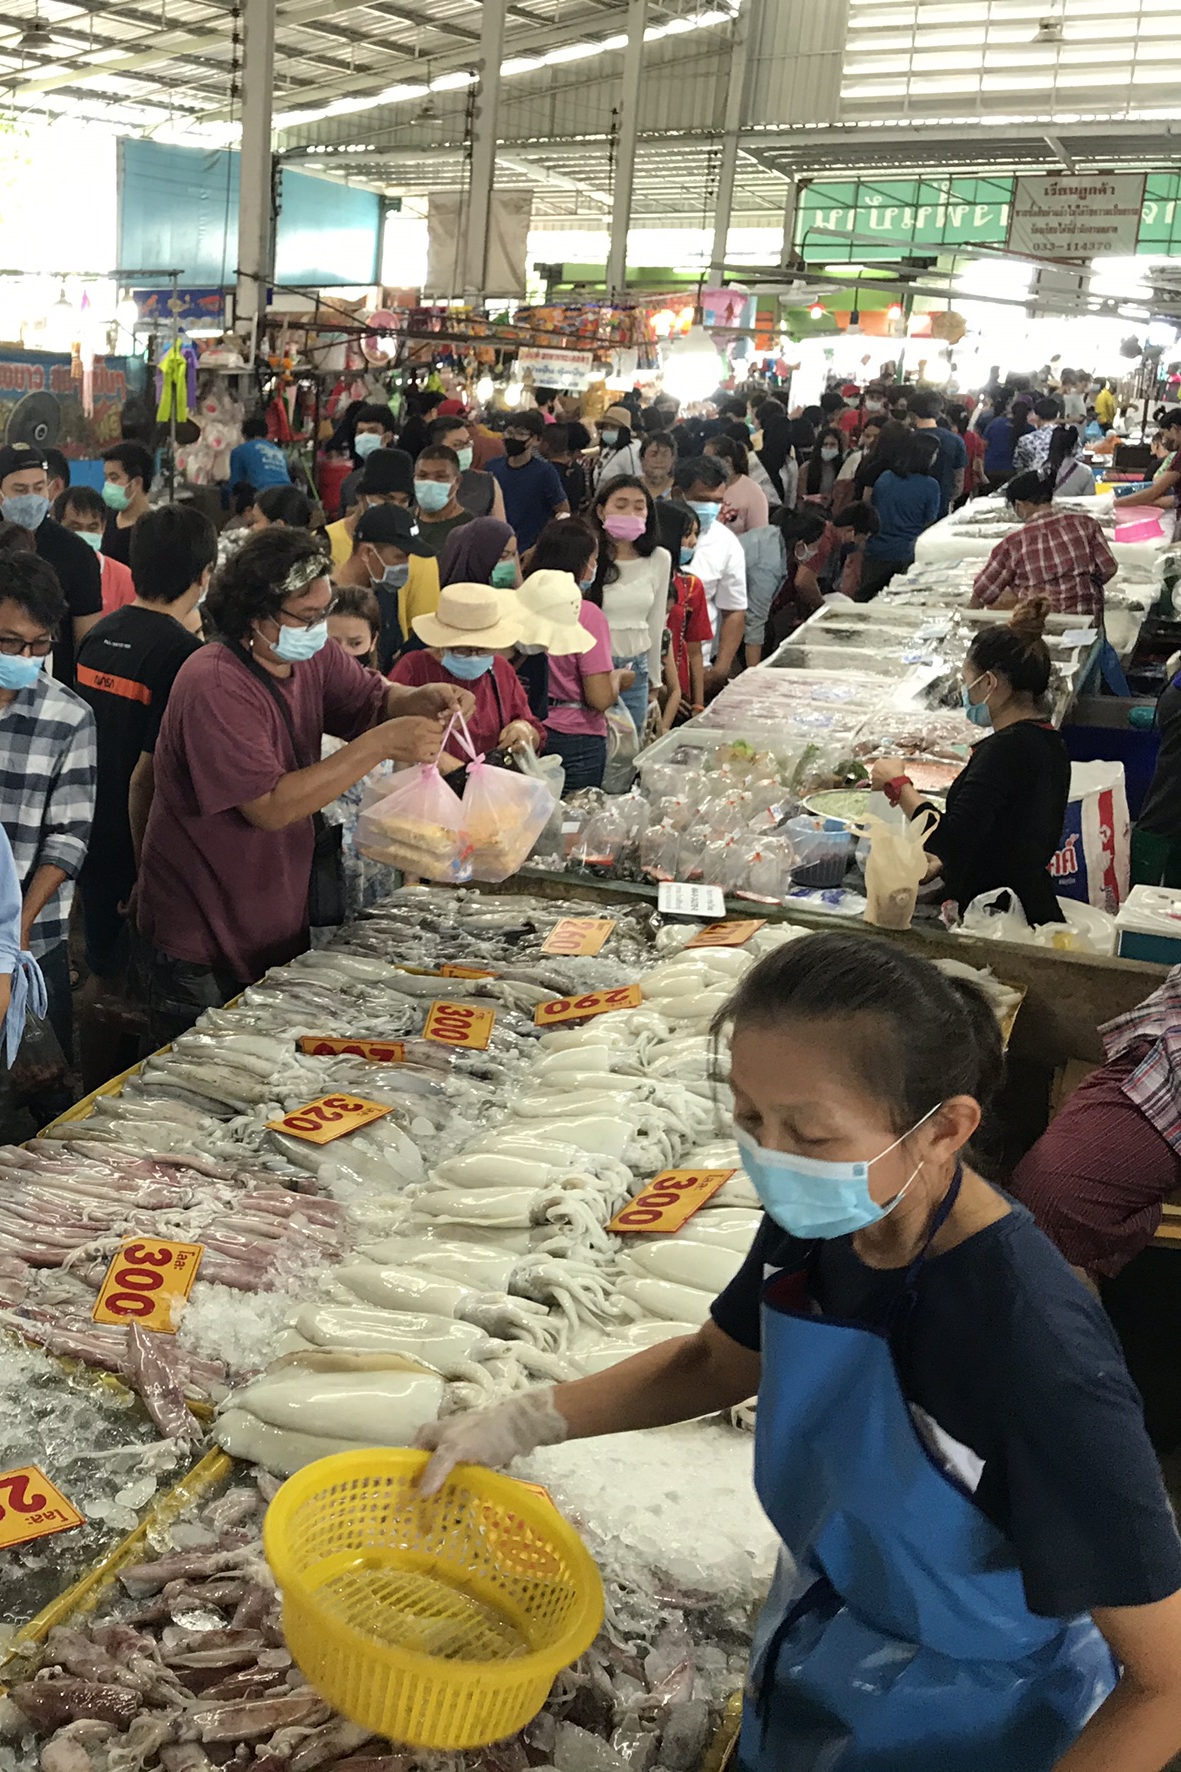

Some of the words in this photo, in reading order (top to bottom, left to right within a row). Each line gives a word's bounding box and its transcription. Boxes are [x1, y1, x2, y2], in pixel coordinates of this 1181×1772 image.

[548, 920, 597, 950] 260
[543, 987, 630, 1016] 290
[431, 1004, 474, 1041] 300
[282, 1097, 364, 1132] 320
[618, 1176, 698, 1225] 300
[105, 1244, 173, 1317] 300
